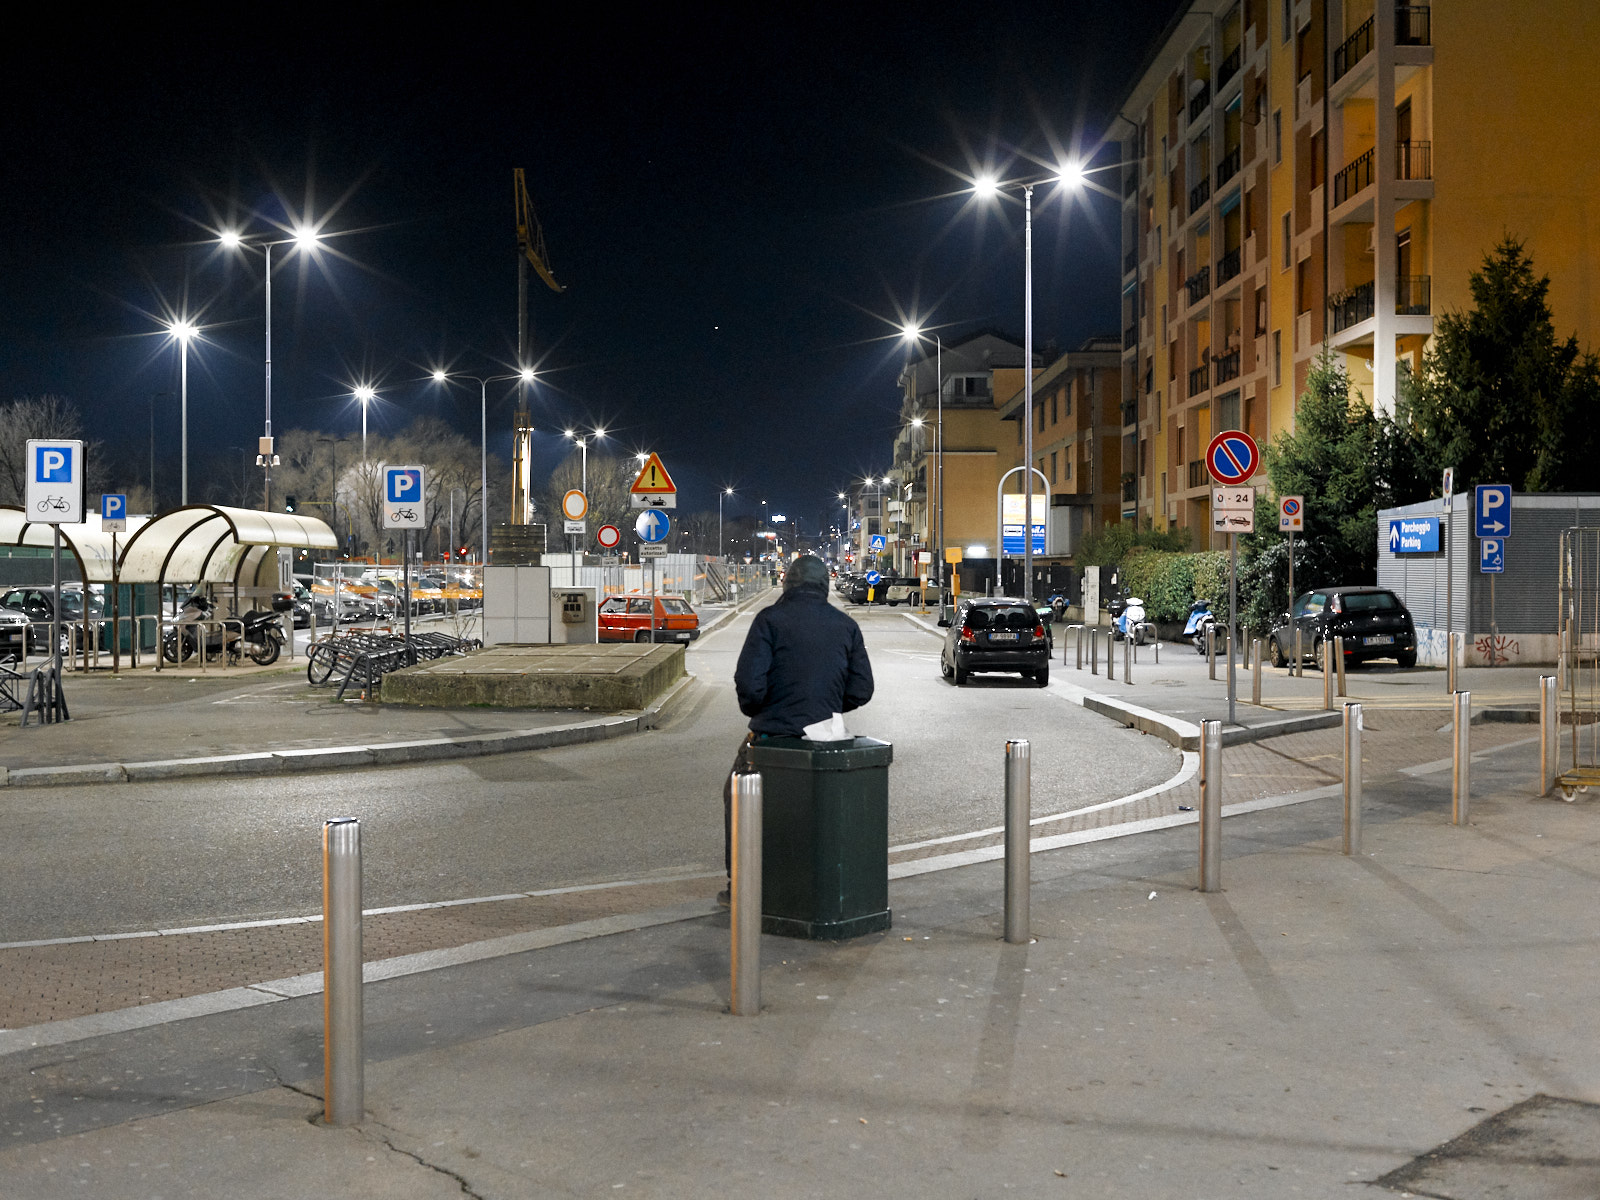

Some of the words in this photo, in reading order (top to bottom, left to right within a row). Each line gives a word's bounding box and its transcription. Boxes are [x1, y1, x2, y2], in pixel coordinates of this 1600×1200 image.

[43, 451, 65, 479] P
[394, 474, 414, 498] P
[106, 496, 122, 518] P
[1217, 494, 1224, 503] 0
[1235, 494, 1249, 503] 24
[1482, 489, 1505, 518] P
[1401, 520, 1431, 536] Parcheggio
[1401, 535, 1421, 550] Parking
[1483, 540, 1499, 560] P
